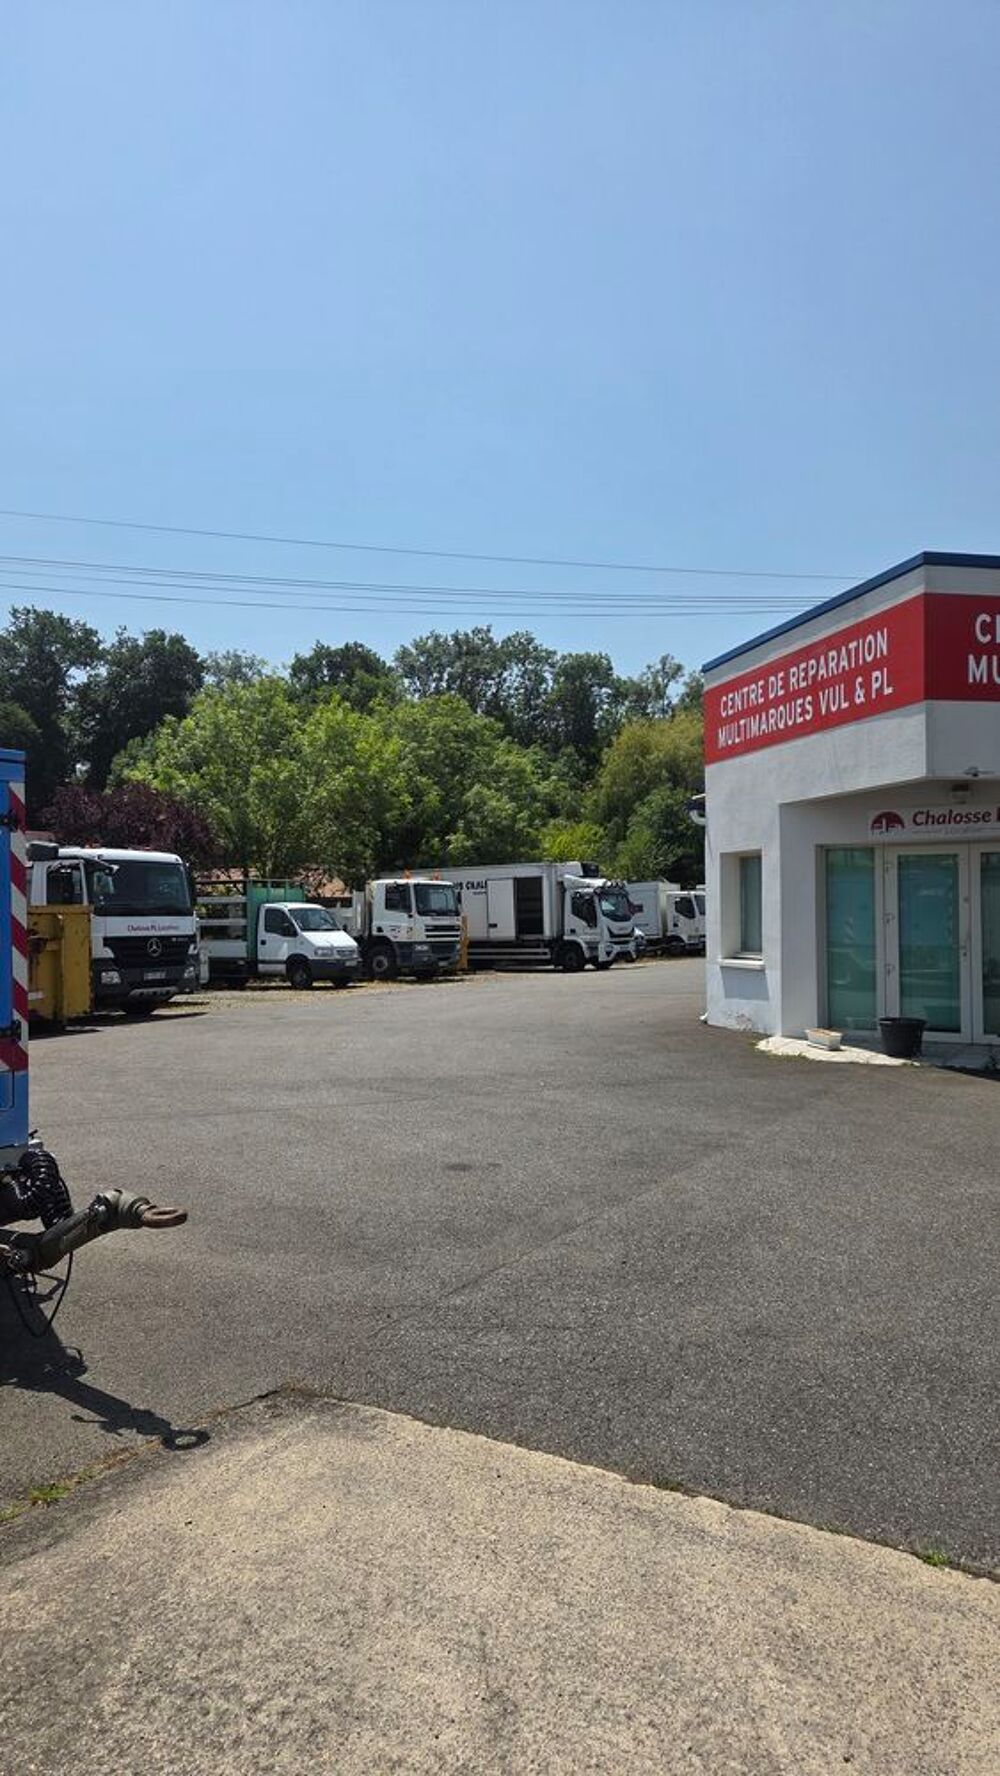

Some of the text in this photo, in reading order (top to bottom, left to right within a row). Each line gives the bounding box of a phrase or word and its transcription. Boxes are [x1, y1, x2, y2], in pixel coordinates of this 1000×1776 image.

[975, 613, 1000, 644] C
[720, 627, 888, 718] CENTRE DE REPARATION
[718, 667, 894, 749] MULTIMARQUES VUL & PL
[912, 809, 992, 826] Chalosse
